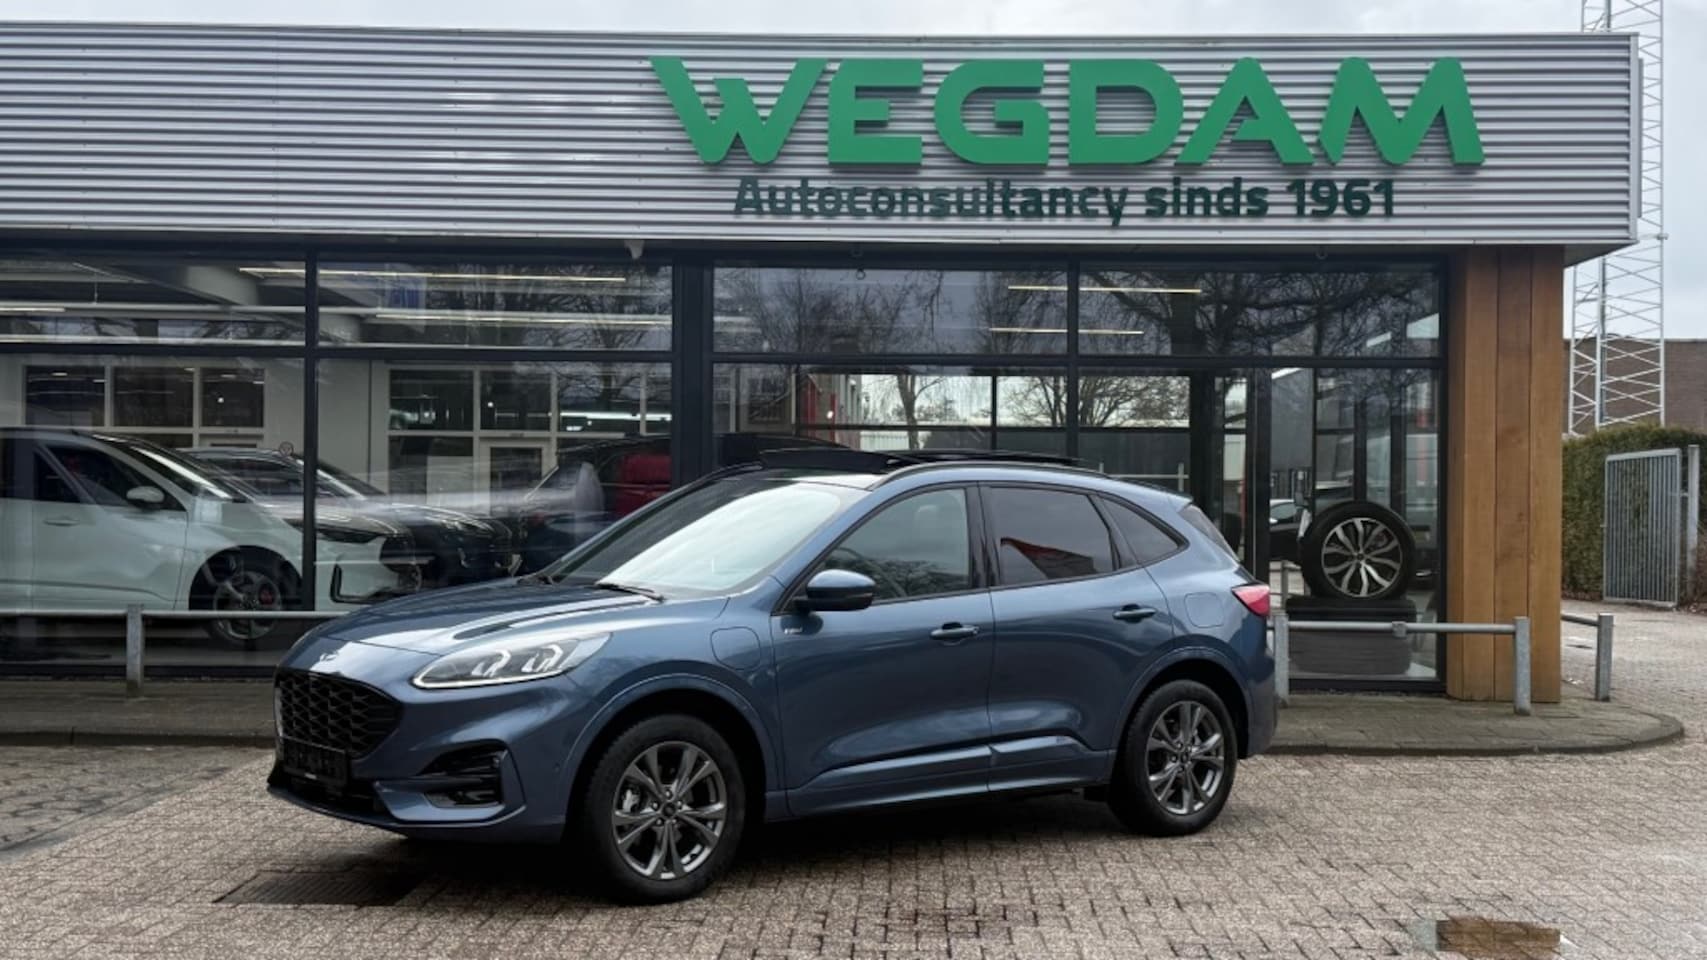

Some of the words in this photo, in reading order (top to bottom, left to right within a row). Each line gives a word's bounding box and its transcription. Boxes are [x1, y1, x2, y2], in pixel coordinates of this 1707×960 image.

[650, 57, 1485, 167] WEGDAM
[734, 177, 1128, 227] Autoconsultancy
[1145, 176, 1269, 217] sinds
[1286, 178, 1394, 217] 1961
